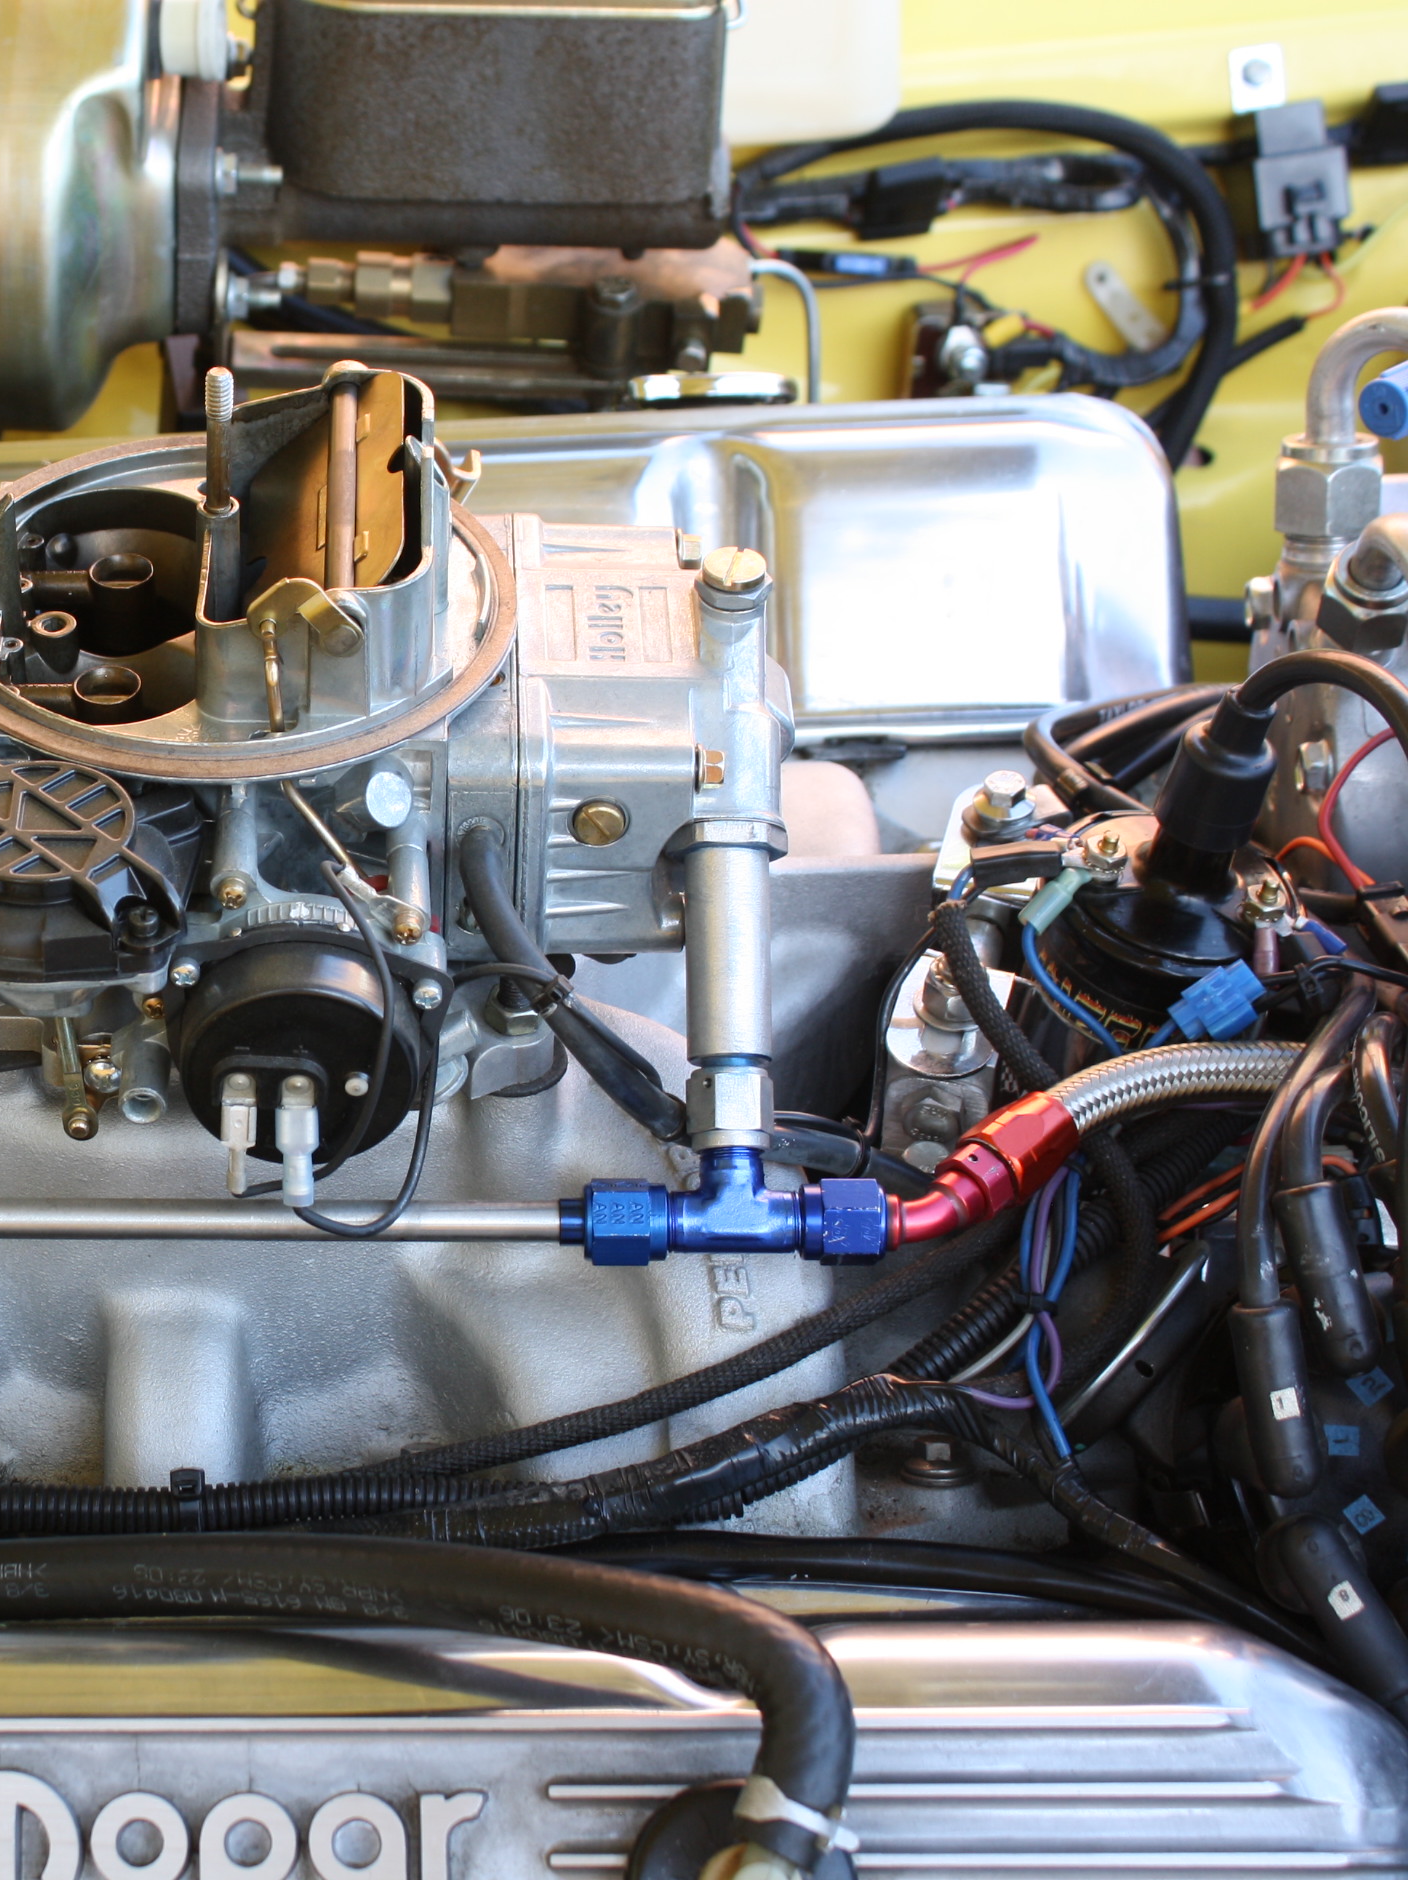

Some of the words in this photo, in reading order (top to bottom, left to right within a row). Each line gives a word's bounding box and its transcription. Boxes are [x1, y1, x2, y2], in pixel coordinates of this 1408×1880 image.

[586, 585, 634, 661] Holley
[594, 1201, 608, 1226] AN
[611, 1201, 627, 1226] AN
[628, 1201, 644, 1226] AN
[704, 1254, 757, 1333] PE
[1361, 1375, 1387, 1396] 2
[1354, 1508, 1376, 1529] 8
[5, 1582, 49, 1599] 3/8
